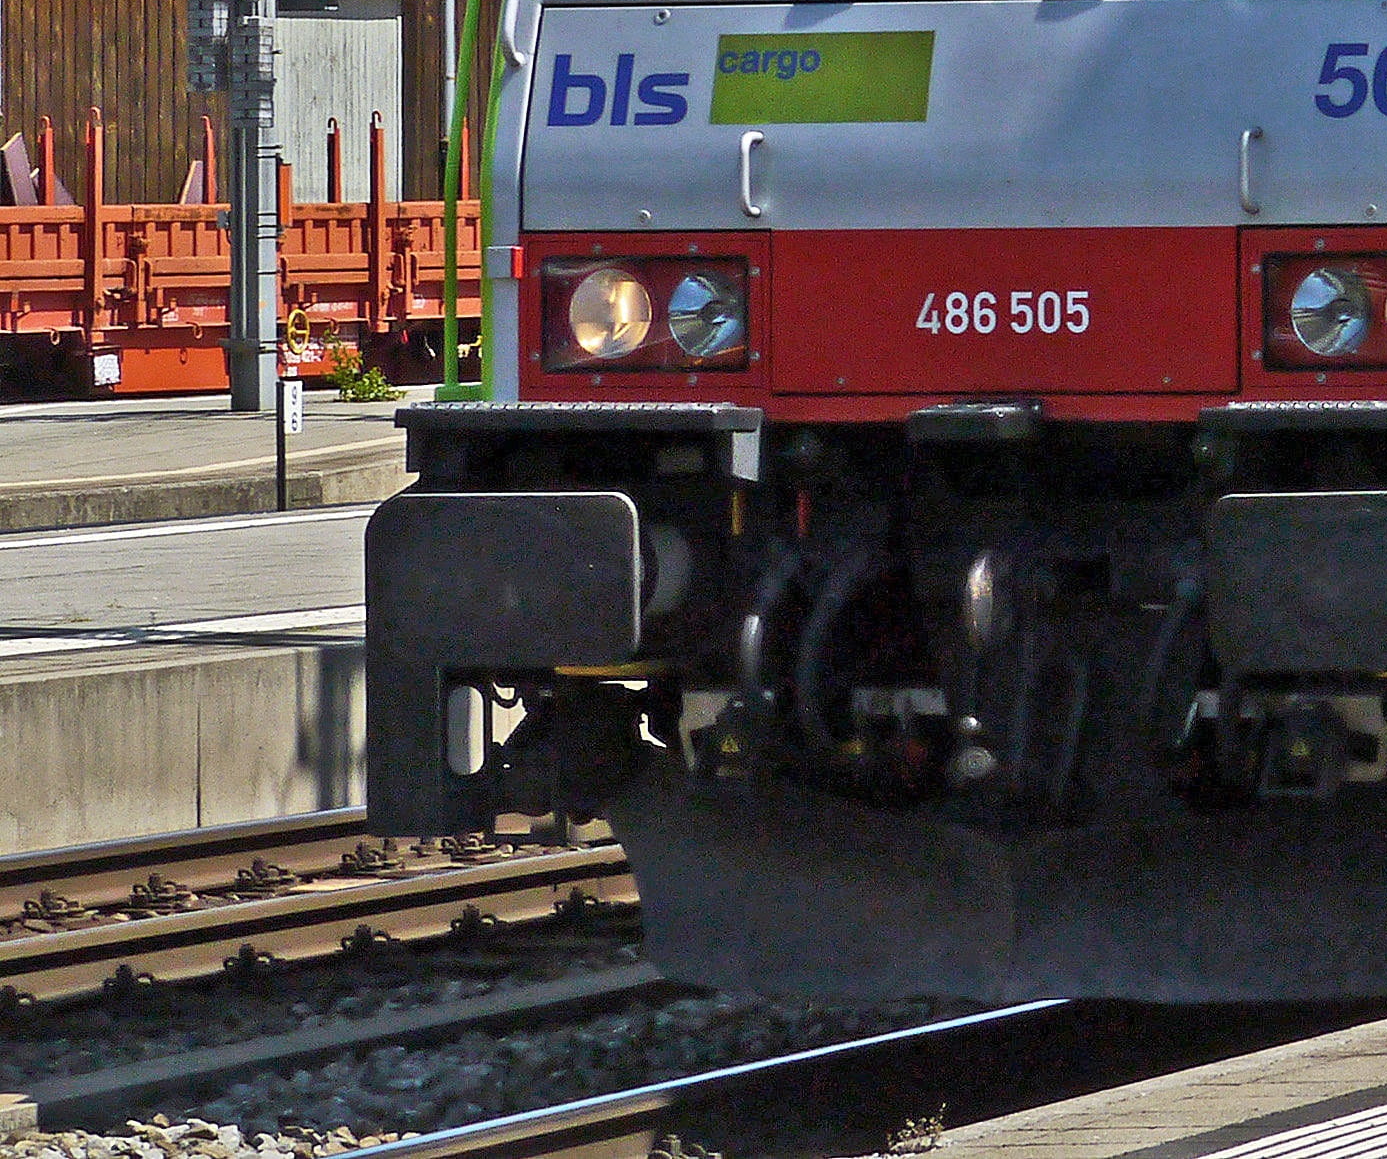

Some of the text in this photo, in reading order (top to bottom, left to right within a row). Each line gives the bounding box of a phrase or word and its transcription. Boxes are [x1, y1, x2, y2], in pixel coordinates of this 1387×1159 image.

[718, 48, 822, 81] cargo
[547, 53, 690, 127] bls
[916, 289, 1090, 335] 486 505
